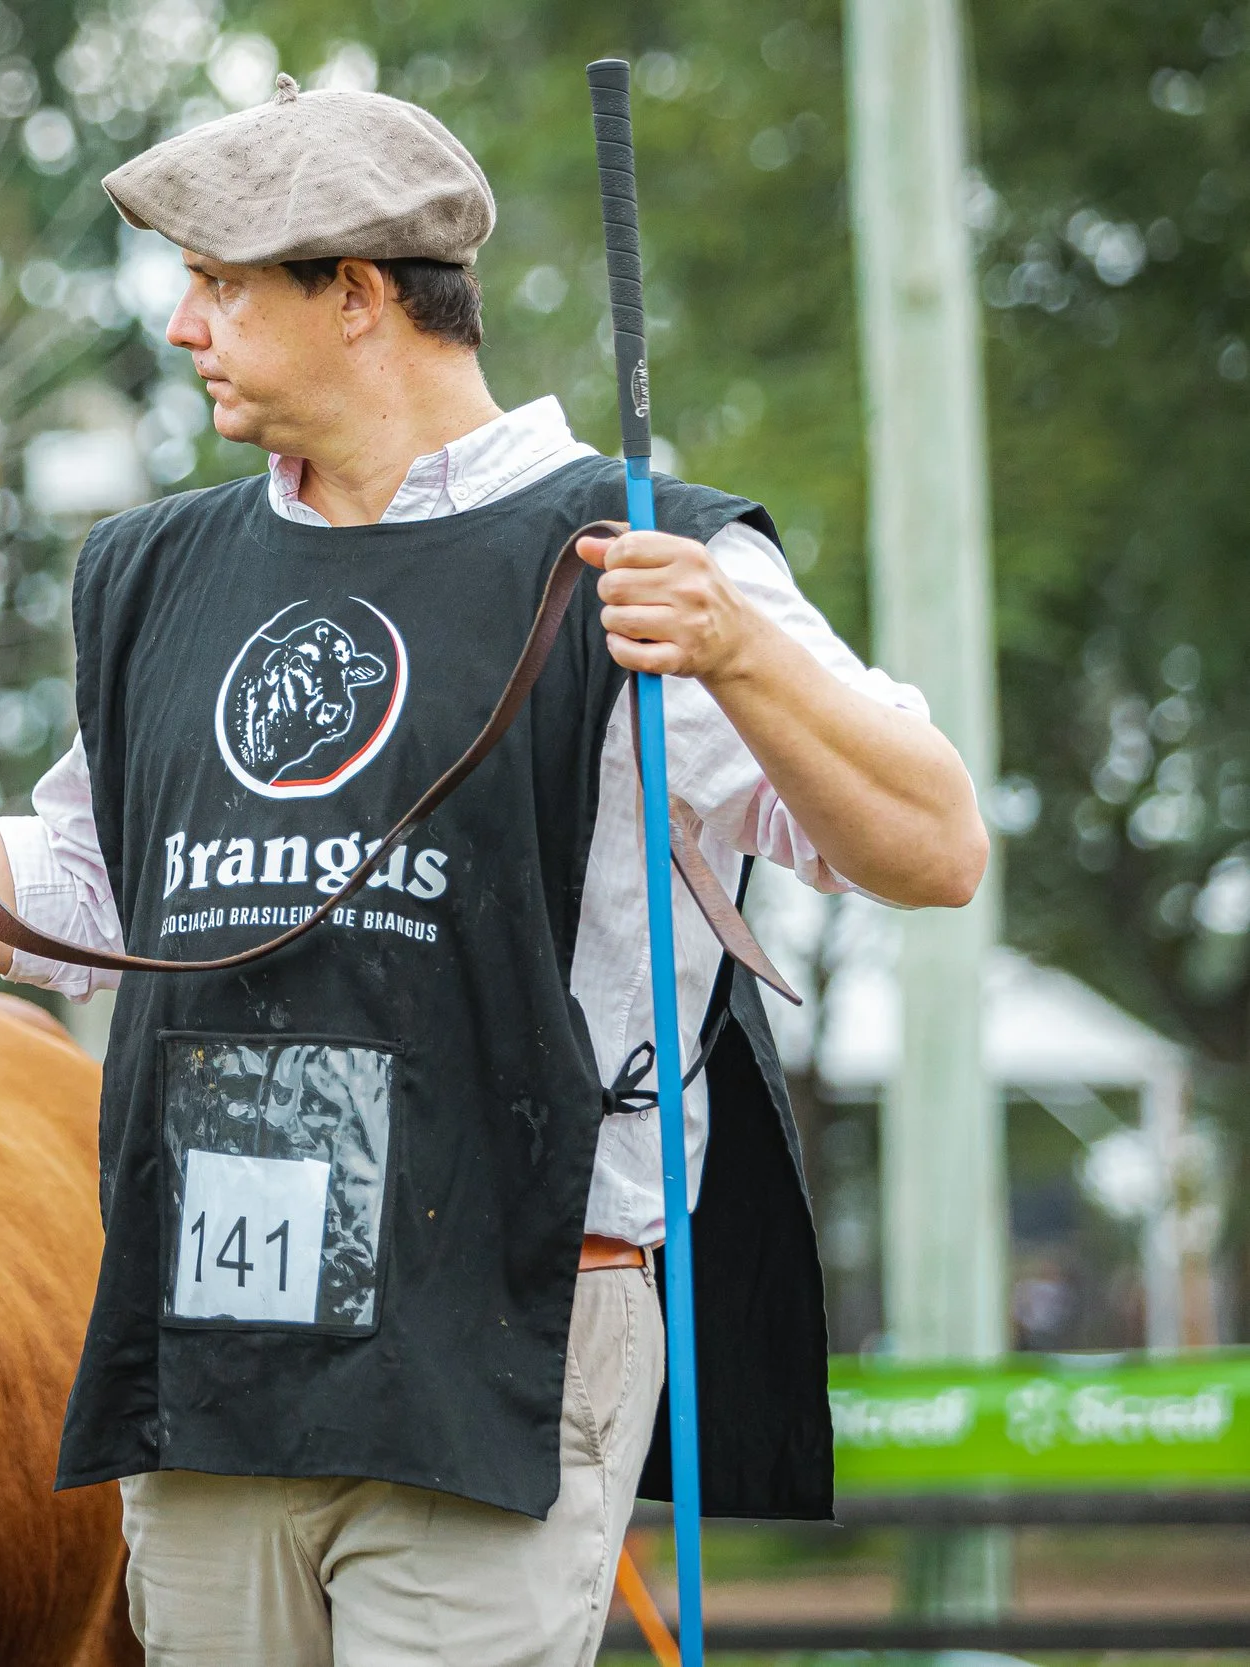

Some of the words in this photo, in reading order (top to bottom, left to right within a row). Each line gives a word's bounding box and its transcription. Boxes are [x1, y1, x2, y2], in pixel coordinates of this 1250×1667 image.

[163, 832, 449, 900] Brangus
[333, 907, 356, 927] DE
[363, 911, 437, 942] BRANGUS
[191, 1211, 289, 1292] 141
